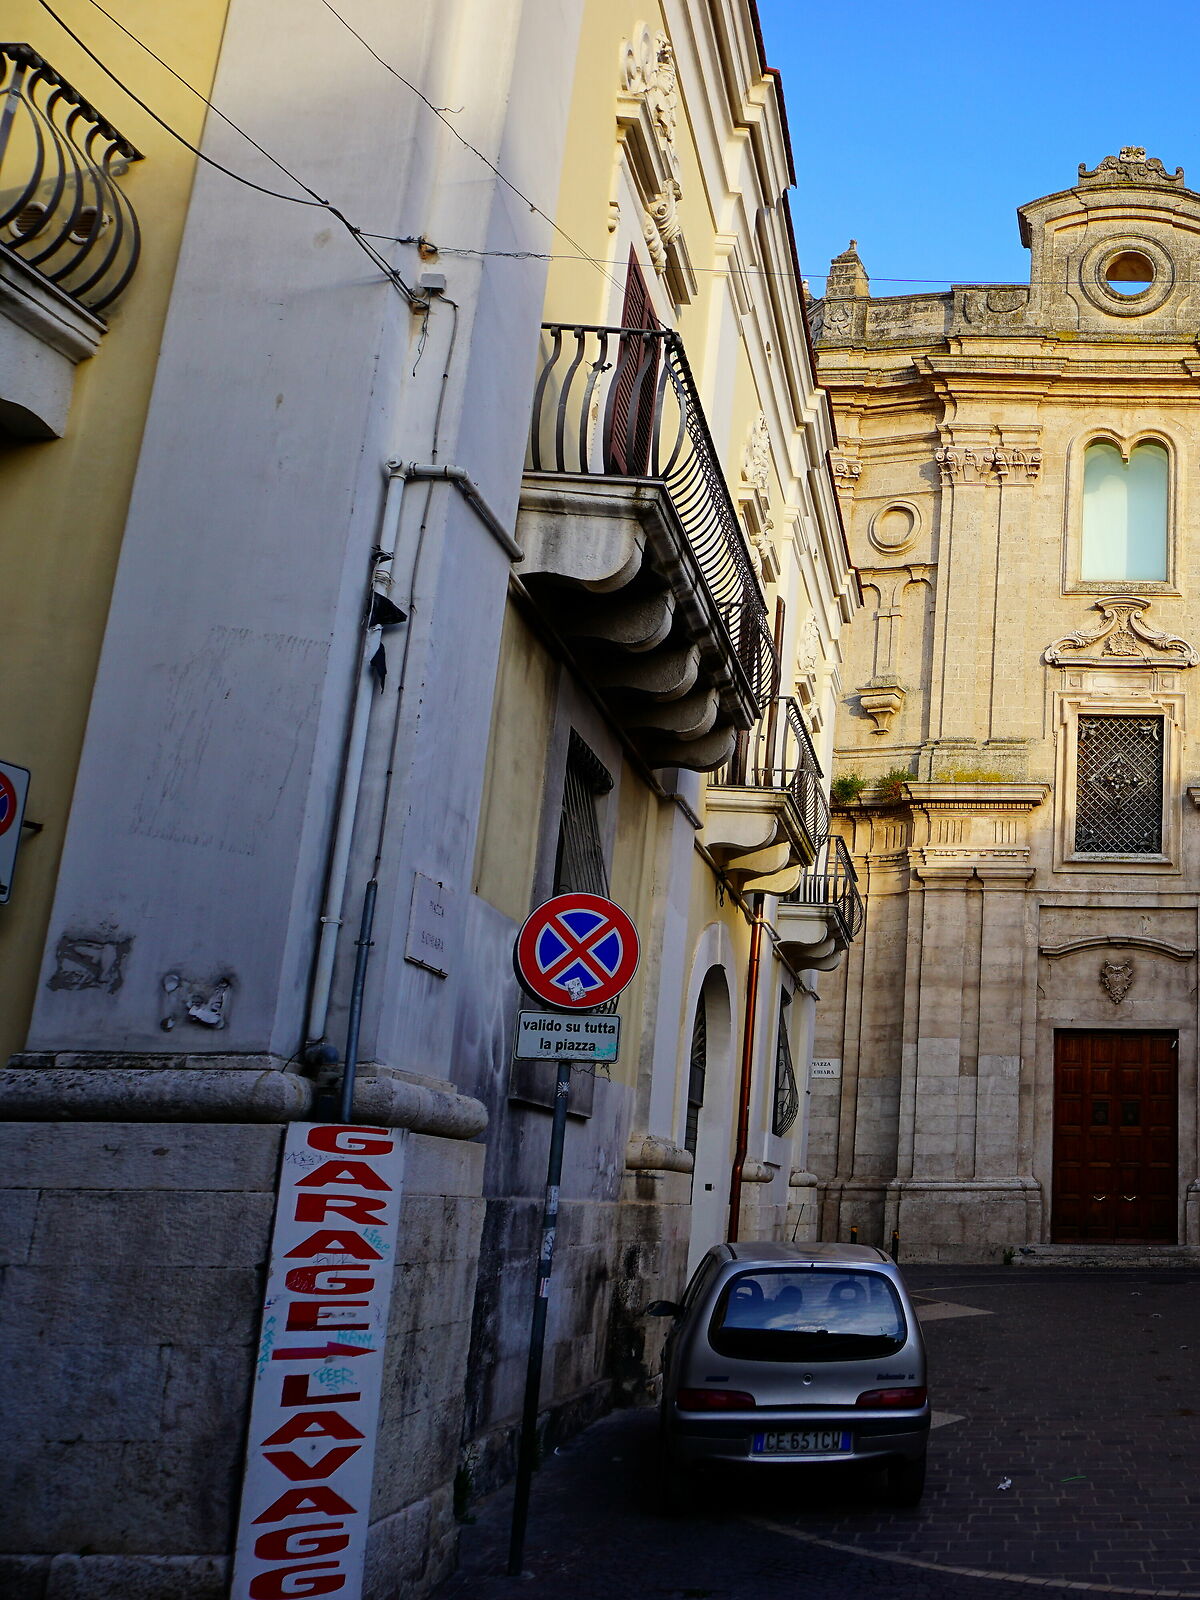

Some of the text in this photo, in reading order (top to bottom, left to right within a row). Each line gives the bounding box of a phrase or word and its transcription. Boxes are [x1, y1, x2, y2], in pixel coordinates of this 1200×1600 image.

[523, 1019, 616, 1034] valido su tutta
[539, 1037, 551, 1050] la
[555, 1039, 596, 1053] piazza
[284, 1126, 394, 1332] GARAGE
[766, 1432, 785, 1451] CE
[790, 1432, 841, 1451] 651CW
[249, 1373, 367, 1600] LAVAGG
